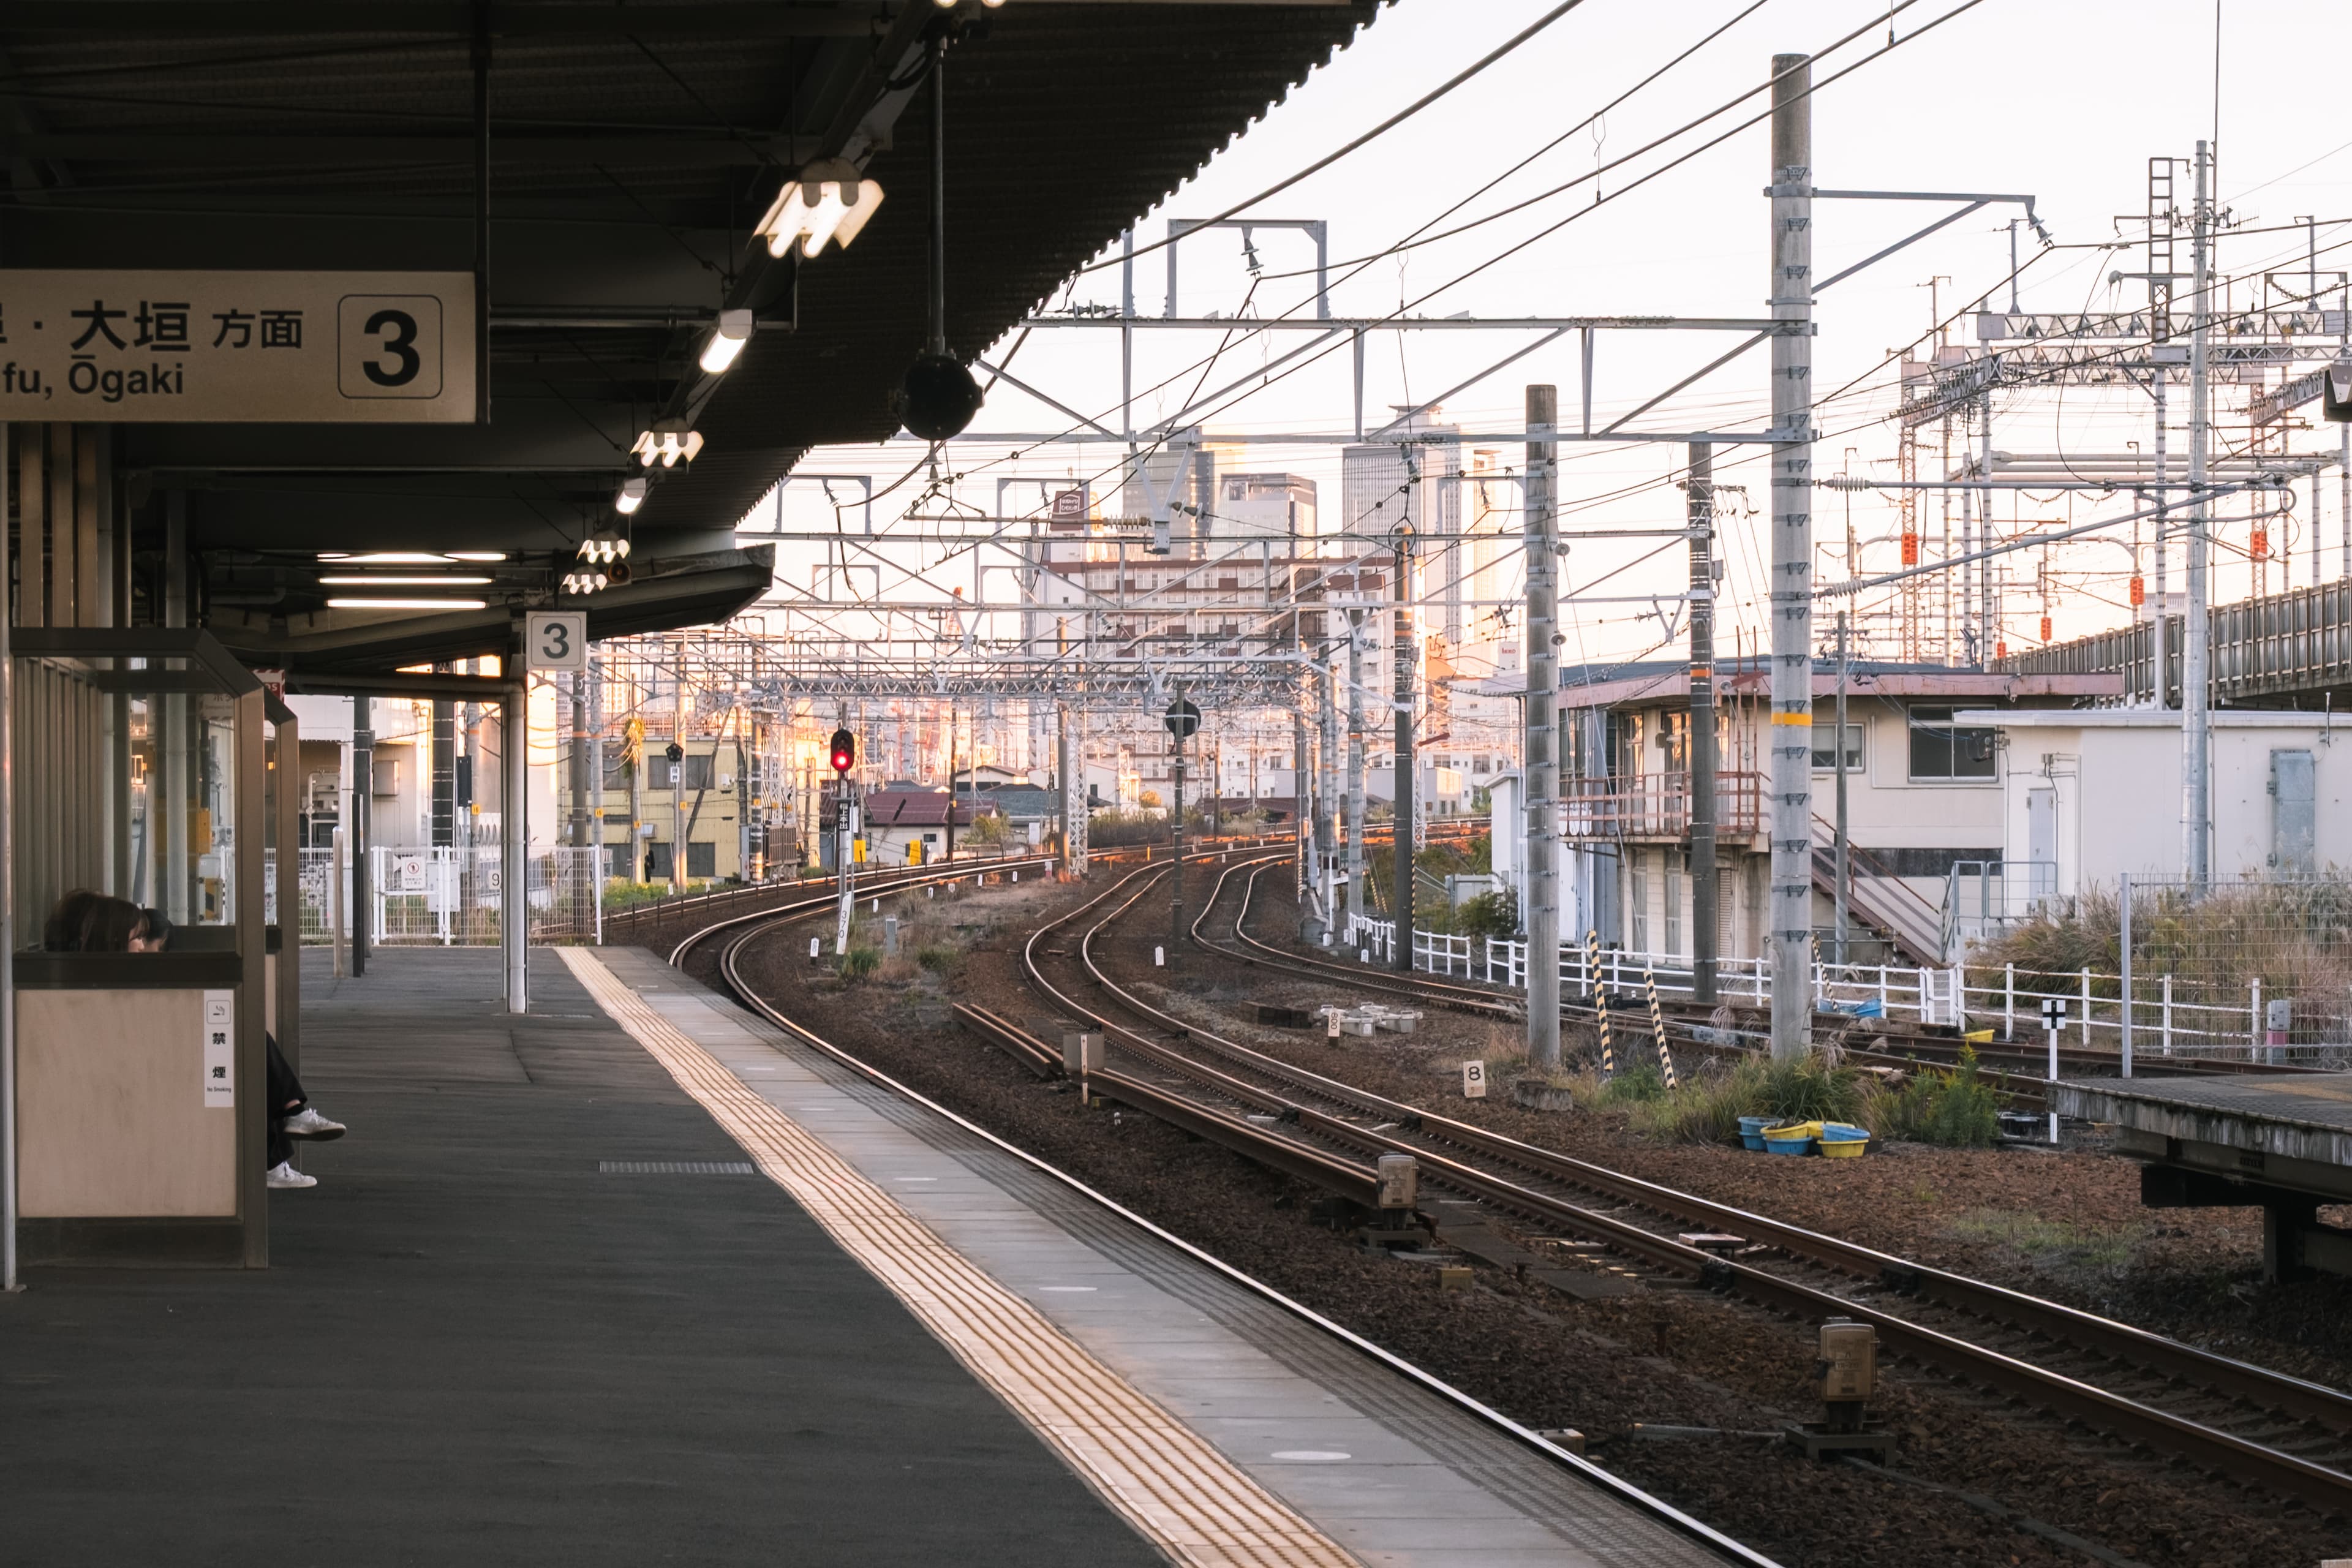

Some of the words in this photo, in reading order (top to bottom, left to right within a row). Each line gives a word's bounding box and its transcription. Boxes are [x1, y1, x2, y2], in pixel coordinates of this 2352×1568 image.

[212, 309, 303, 349] 方面
[362, 309, 421, 387] 3
[69, 355, 184, 402] Ōgaki
[543, 623, 570, 659] 3
[492, 873, 500, 886] 9
[839, 910, 847, 938] 370
[212, 1032, 226, 1079] 禁煙
[1468, 1066, 1481, 1081] 8
